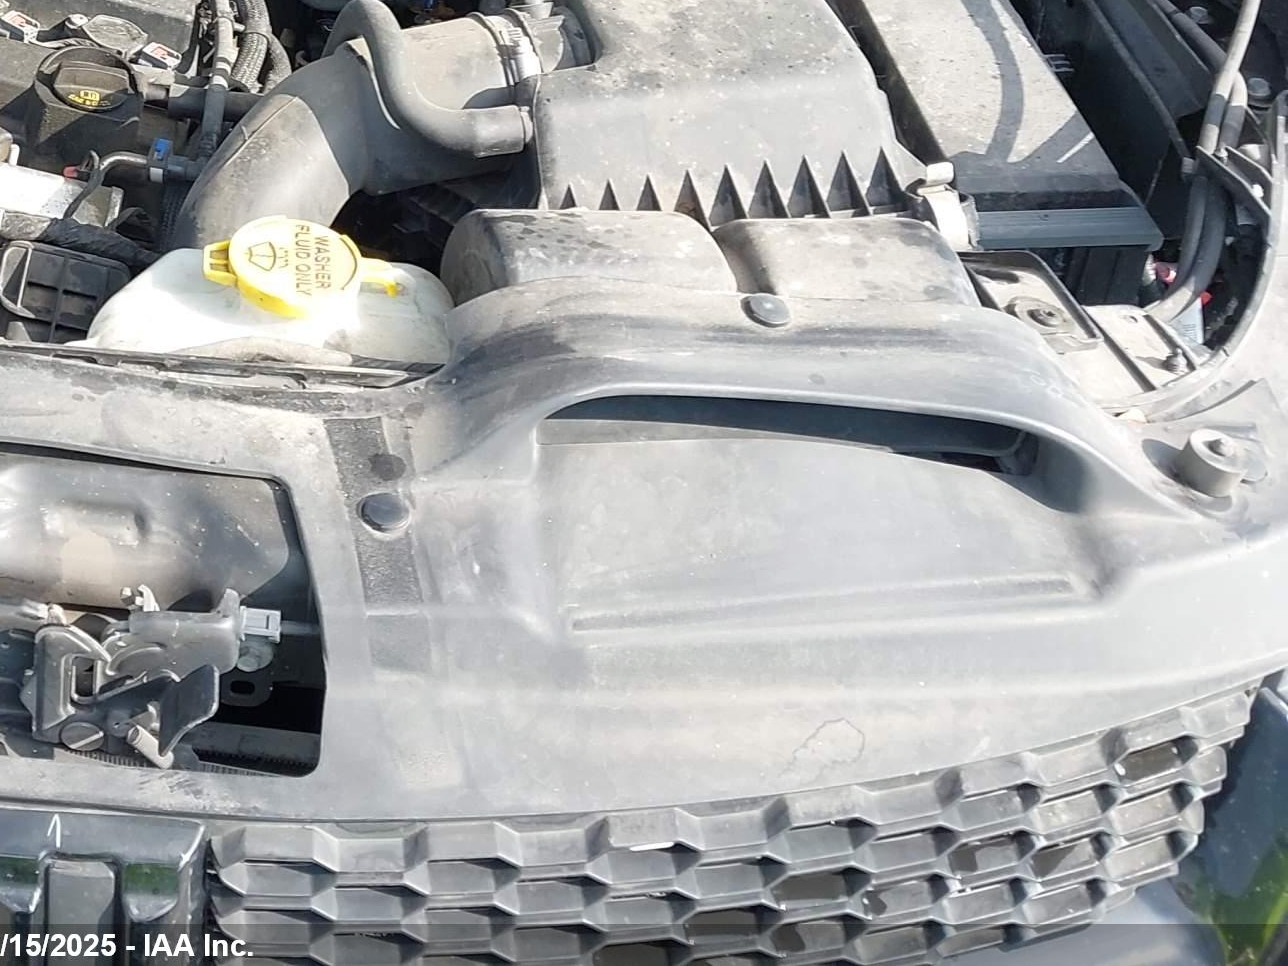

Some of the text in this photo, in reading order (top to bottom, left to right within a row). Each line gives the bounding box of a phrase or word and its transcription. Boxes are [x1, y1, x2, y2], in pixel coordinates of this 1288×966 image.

[294, 224, 313, 297] FLUID ONLY
[314, 235, 332, 290] WASHER
